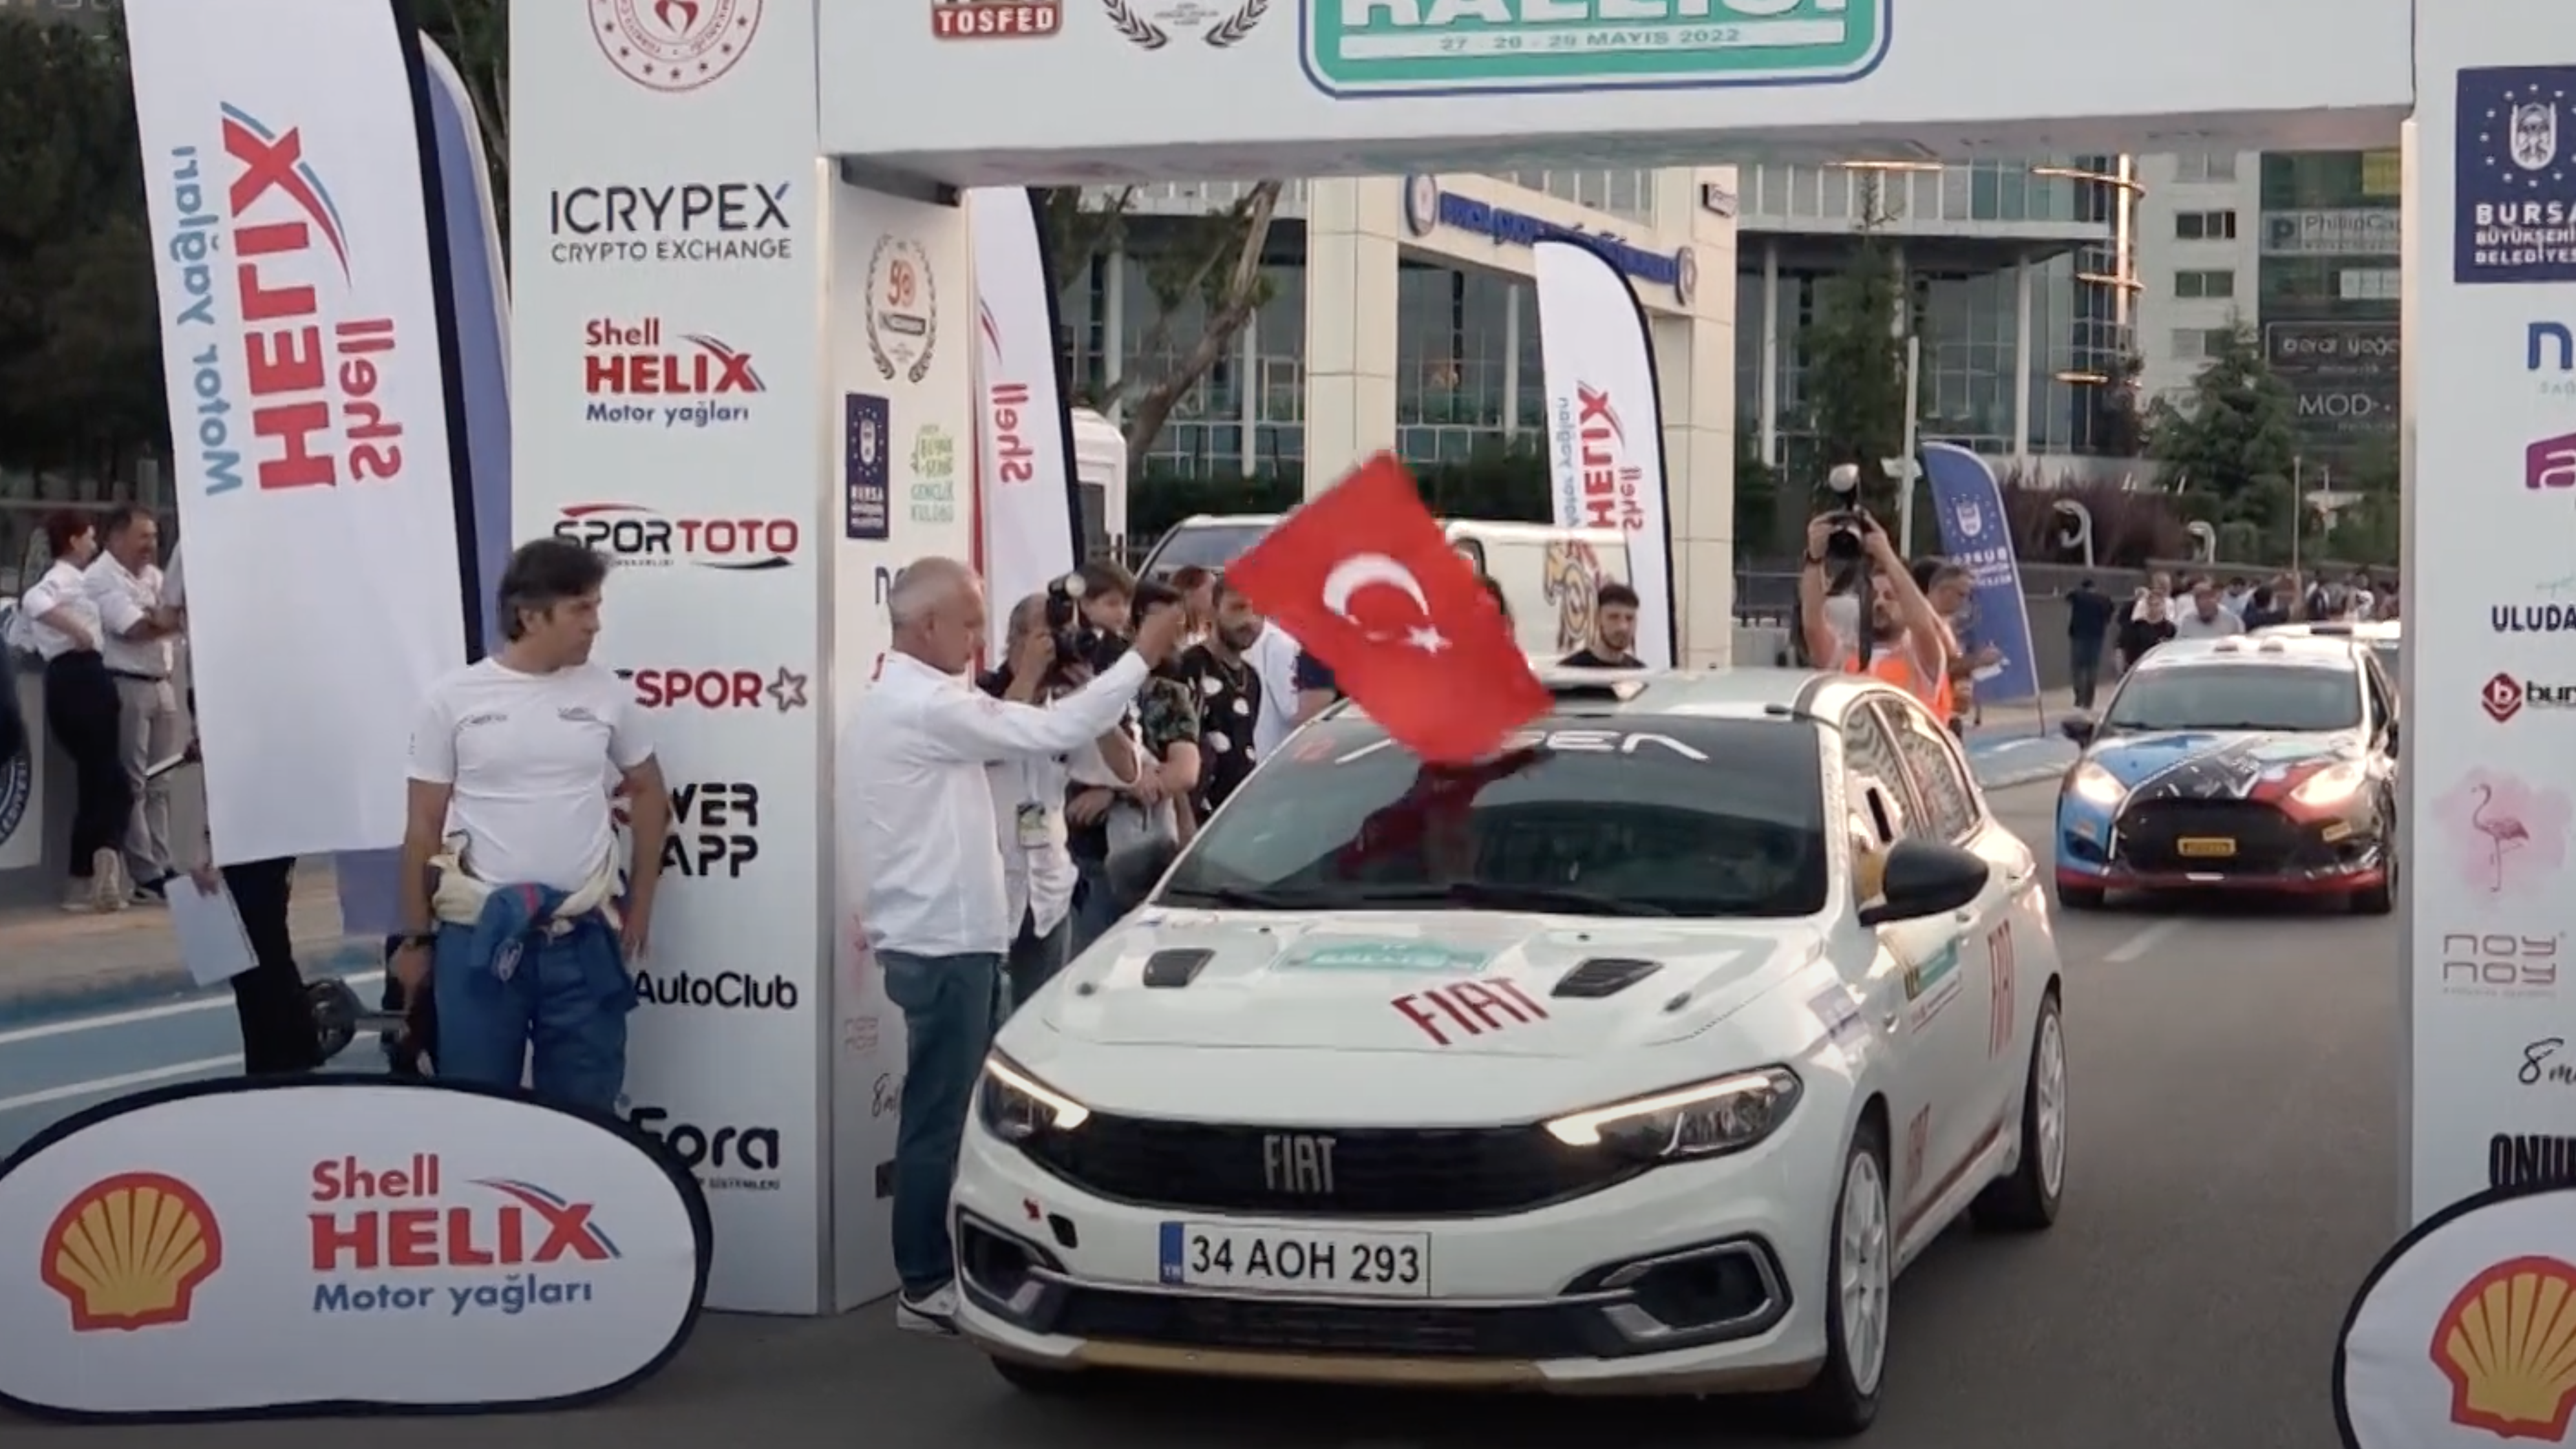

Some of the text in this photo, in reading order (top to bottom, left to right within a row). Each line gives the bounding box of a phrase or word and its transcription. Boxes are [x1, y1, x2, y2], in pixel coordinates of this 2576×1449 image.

[937, 6, 1054, 32] TOSFED
[1586, 30, 1670, 46] MAYIS
[1680, 28, 1740, 43] 2022
[550, 182, 791, 235] ICRYPEX
[551, 237, 792, 263] CRYPTO EXCHANGE
[584, 317, 660, 347] Shell
[584, 353, 759, 394] HELIX
[585, 398, 750, 428] Motor yağları
[633, 969, 799, 1010] AutoClub
[1390, 976, 1550, 1046] FIAT
[311, 1153, 440, 1201] Shell
[1262, 1134, 1337, 1193] FIAT
[307, 1202, 612, 1272] HELIX
[1192, 1234, 1420, 1284] 34 AOH 293
[313, 1273, 593, 1317] Motor yağları
